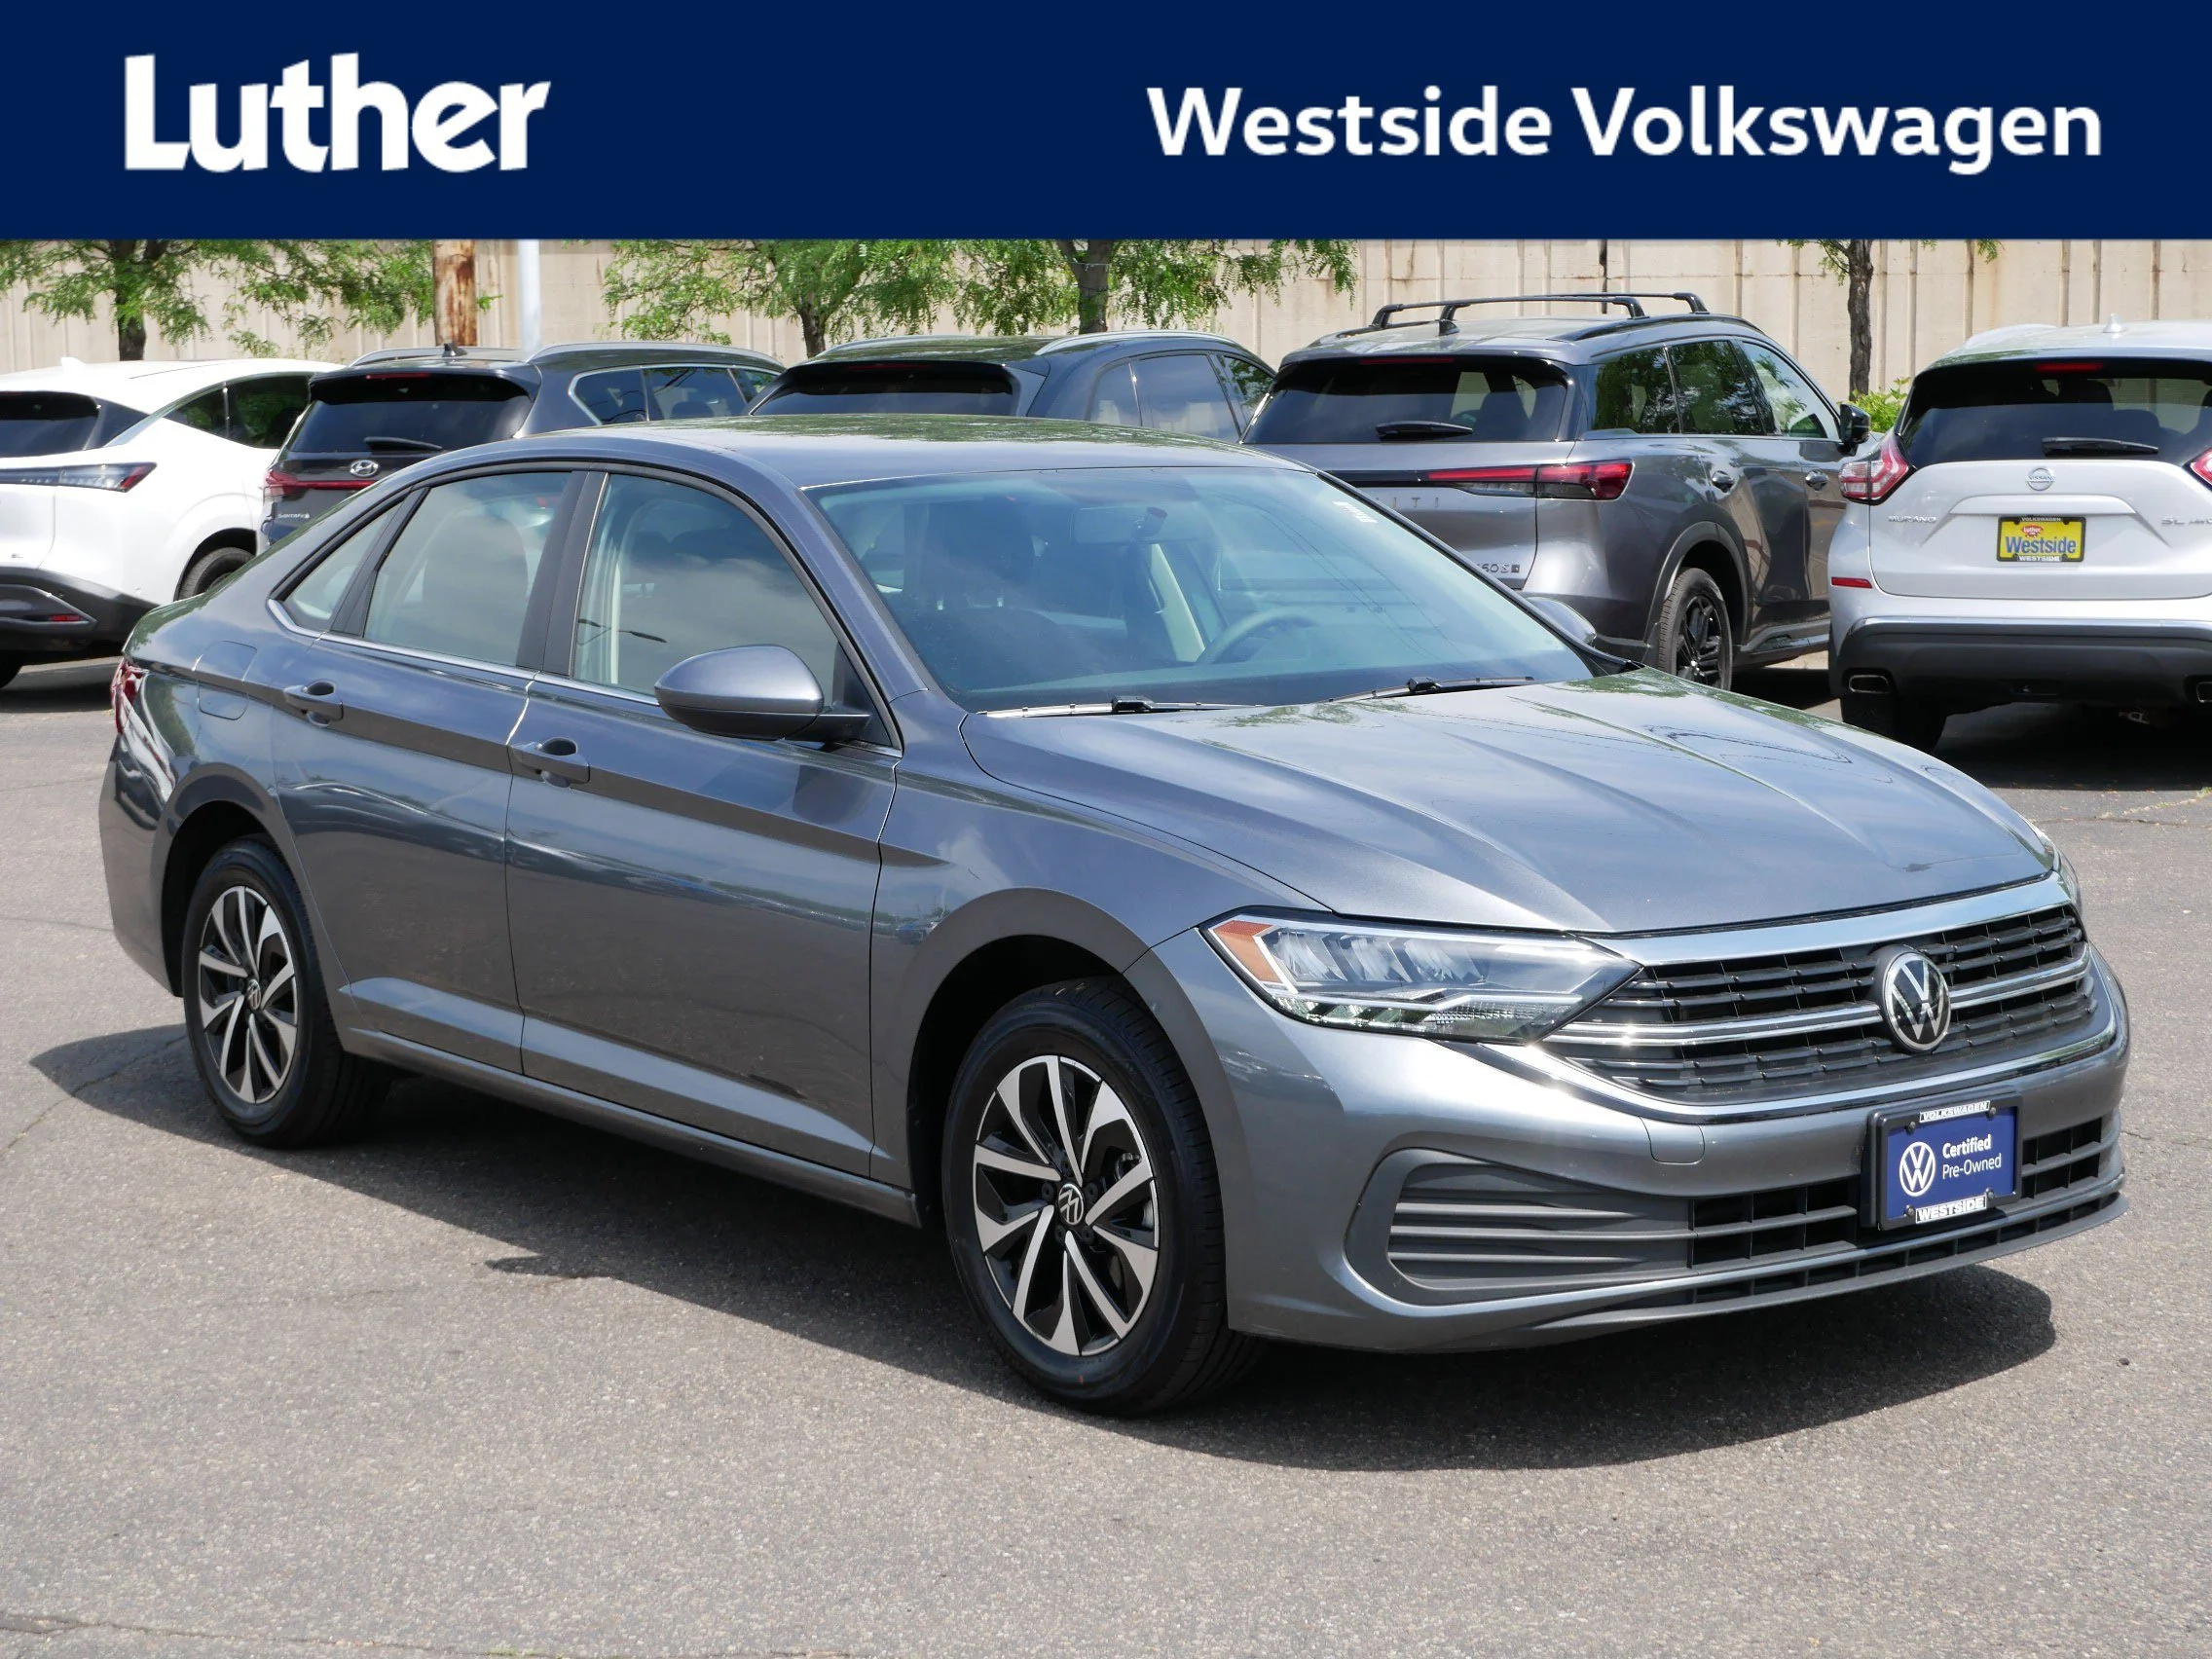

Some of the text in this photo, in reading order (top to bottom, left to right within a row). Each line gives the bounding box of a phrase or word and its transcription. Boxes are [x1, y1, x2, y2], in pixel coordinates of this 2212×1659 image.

[2006, 536, 2076, 553] Westside
[1922, 1101, 1989, 1121] VOLKSWAGEN
[1942, 1134, 1992, 1159] Certified
[1942, 1154, 2002, 1180] Pre-Owned
[1917, 1198, 1985, 1221] WESTSIDE
